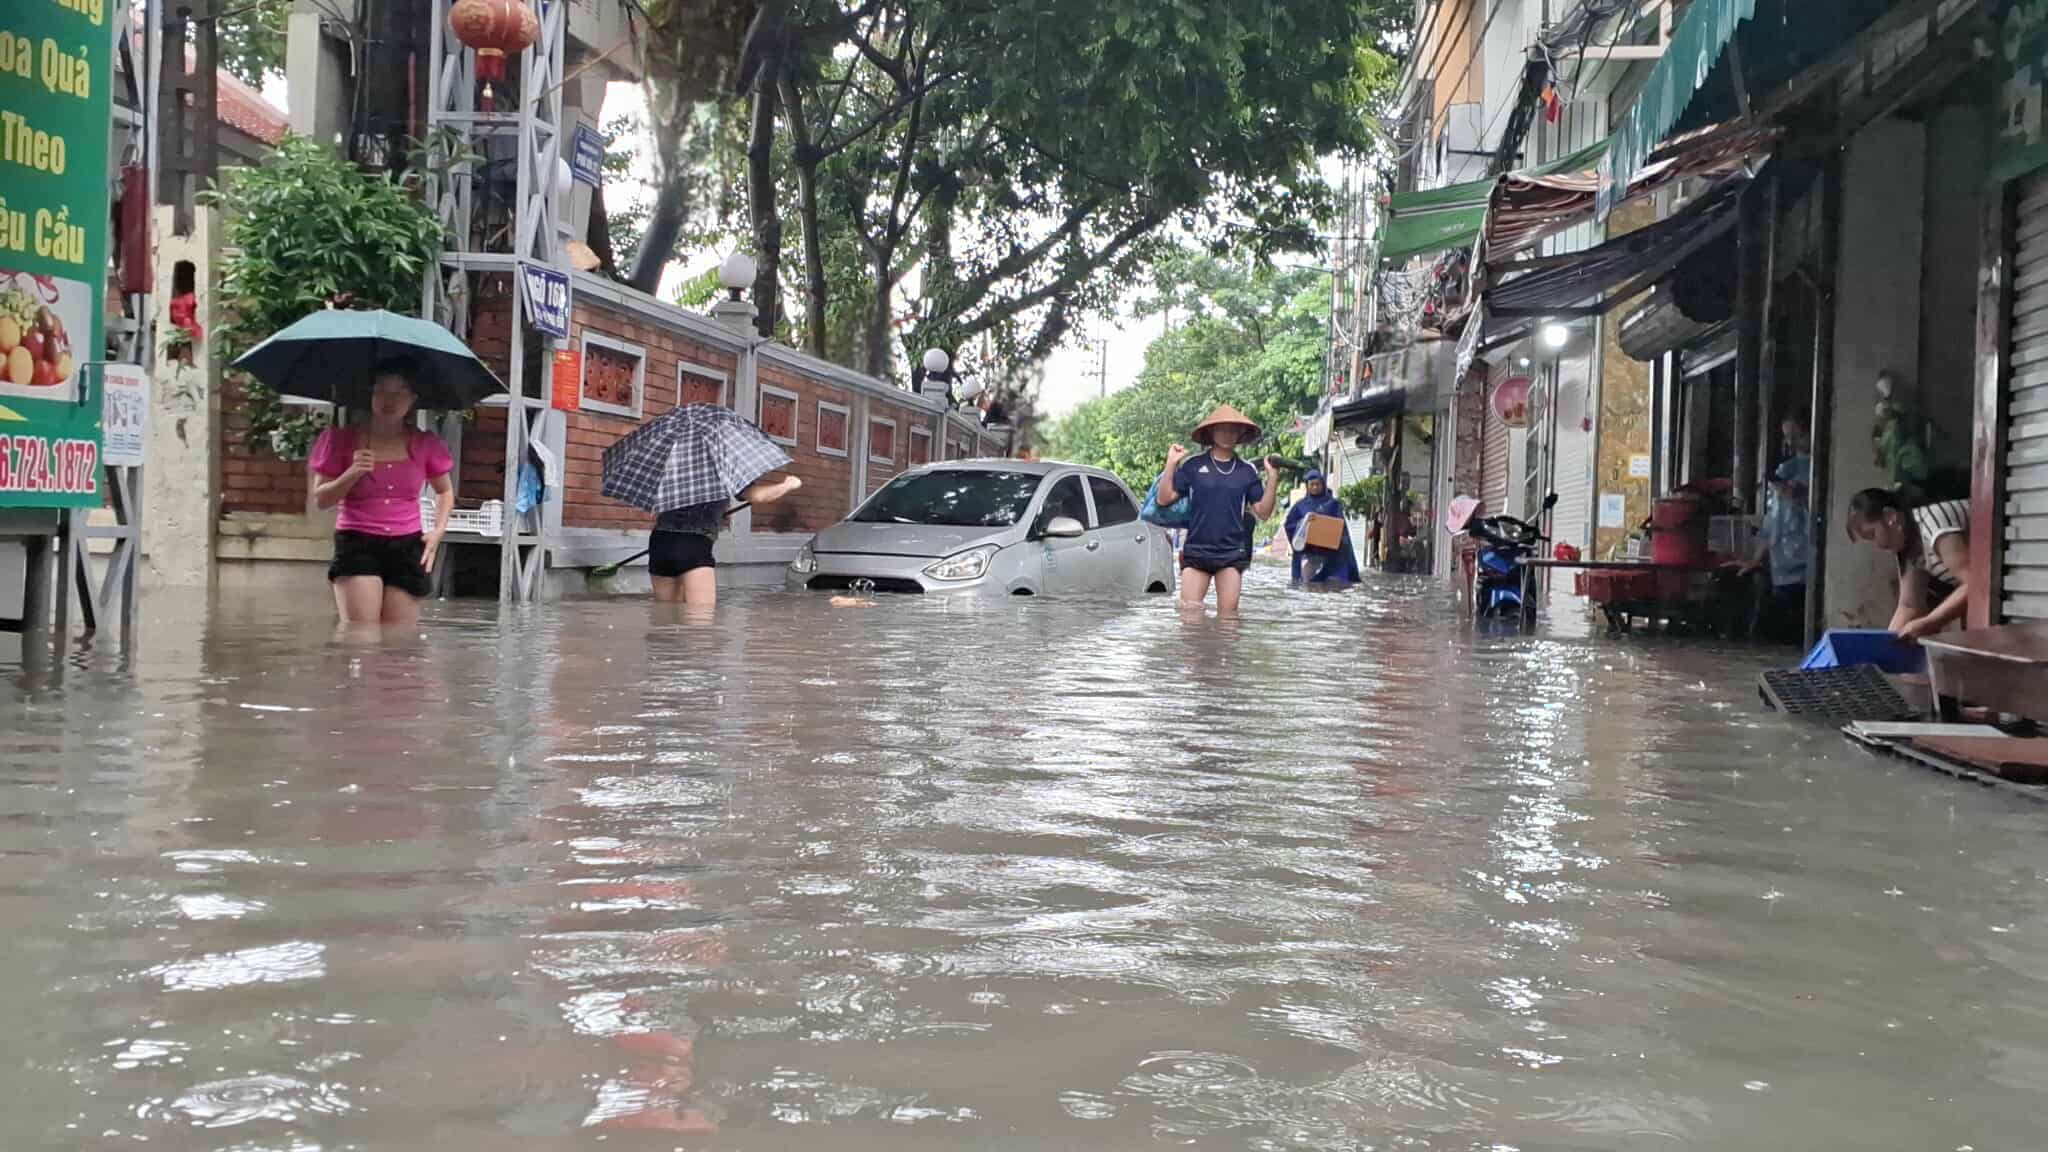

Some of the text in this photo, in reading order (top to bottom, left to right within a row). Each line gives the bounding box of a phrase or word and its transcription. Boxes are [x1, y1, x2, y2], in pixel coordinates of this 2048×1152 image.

[41, 38, 90, 98] Quả
[2, 110, 66, 175] Theo
[35, 204, 85, 264] Cầu
